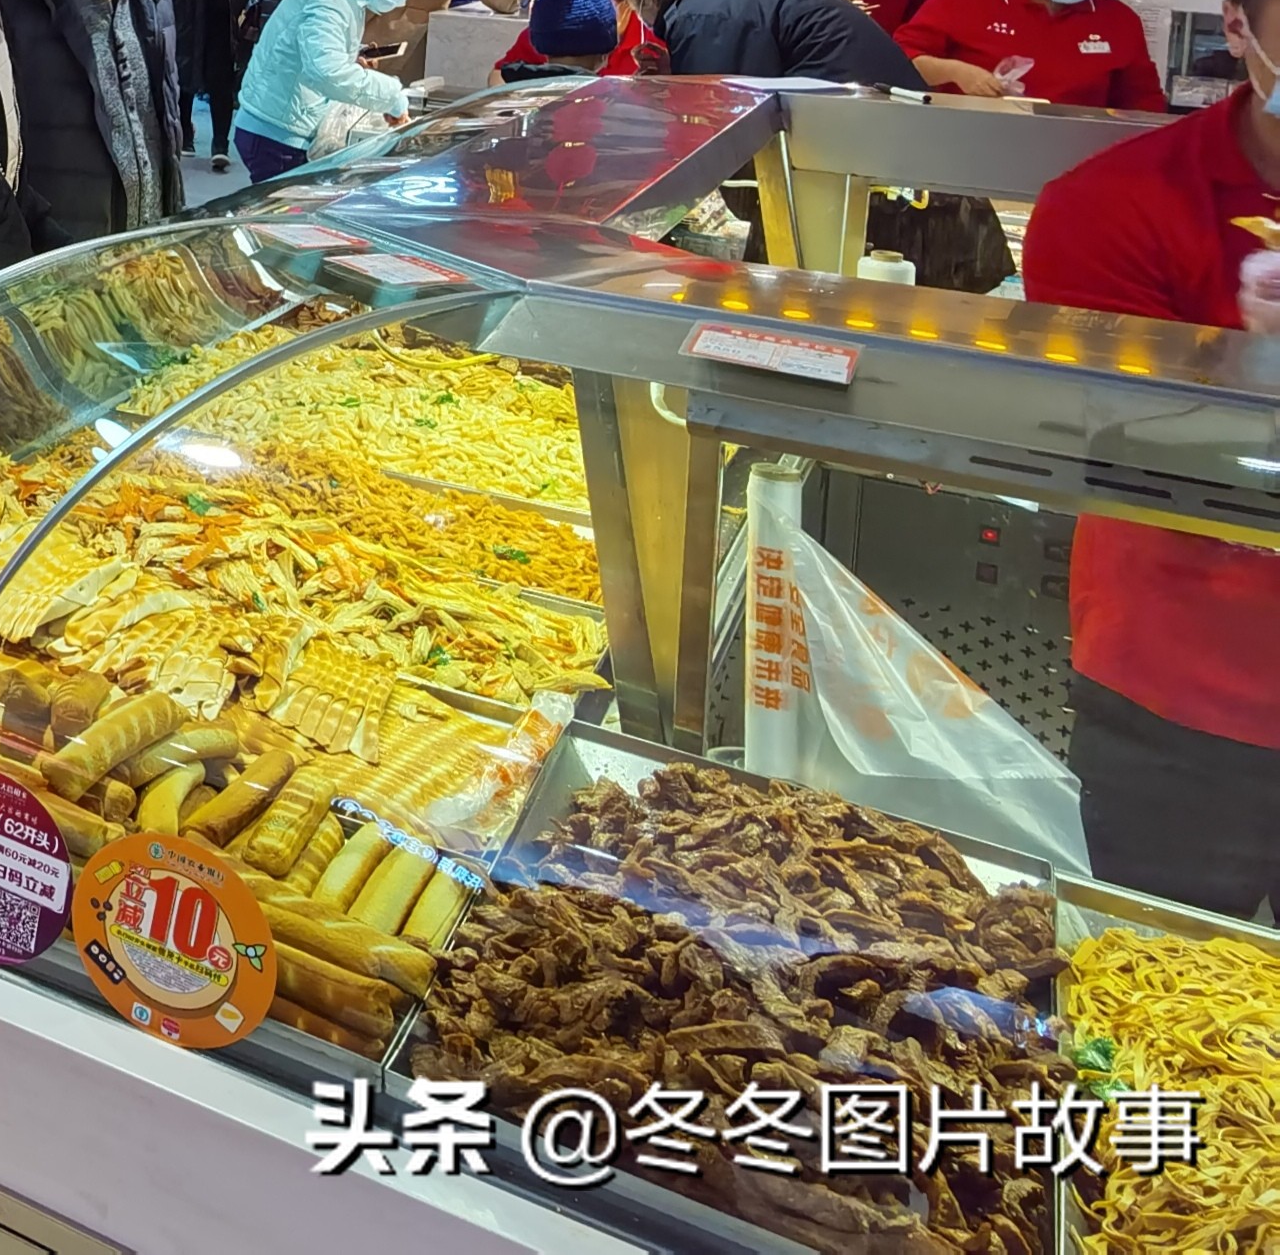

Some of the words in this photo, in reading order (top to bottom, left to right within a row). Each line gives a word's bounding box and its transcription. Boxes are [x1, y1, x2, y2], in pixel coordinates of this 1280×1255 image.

[754, 545, 784, 711] 决定健康未来
[168, 849, 224, 883] 中国农业银行
[148, 876, 219, 961] 10
